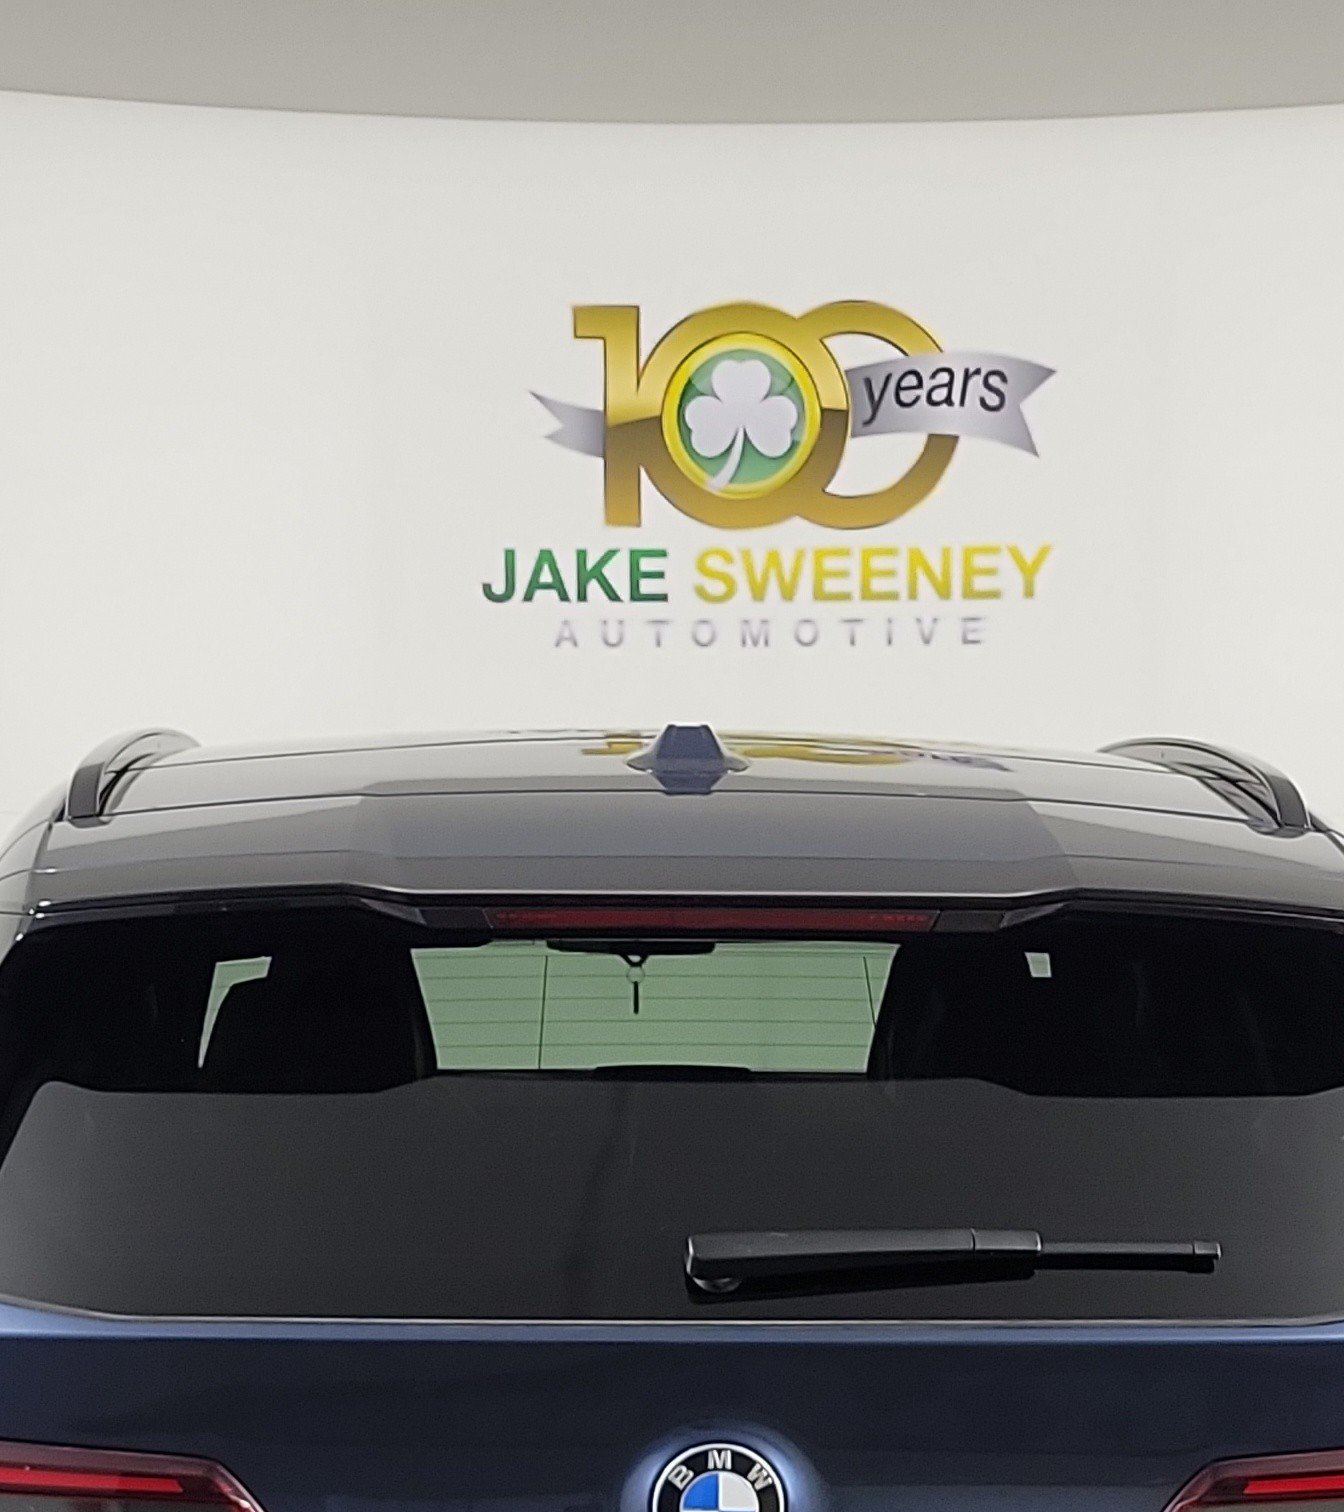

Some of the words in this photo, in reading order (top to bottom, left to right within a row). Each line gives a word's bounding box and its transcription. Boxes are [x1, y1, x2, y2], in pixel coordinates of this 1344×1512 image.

[572, 300, 958, 530] 100
[862, 366, 1008, 426] years
[482, 547, 669, 604] JAKE
[693, 543, 1052, 604] SWEENEY
[555, 616, 984, 648] AUTOMOTIVE
[667, 1449, 774, 1491] BMW
